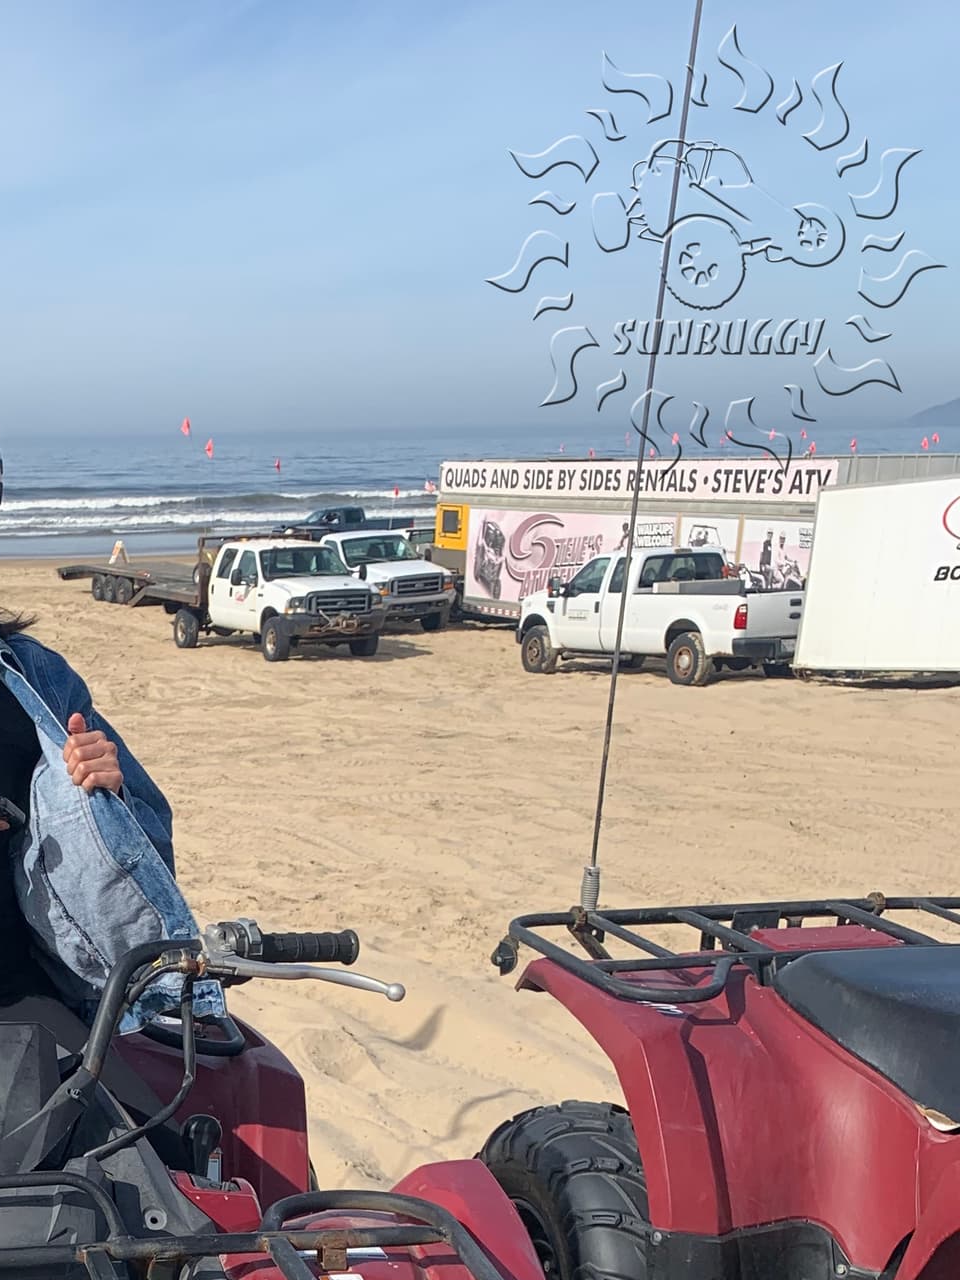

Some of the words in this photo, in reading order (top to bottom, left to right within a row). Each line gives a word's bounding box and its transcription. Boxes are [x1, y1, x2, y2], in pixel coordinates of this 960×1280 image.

[444, 468, 487, 489] QUADS
[490, 468, 520, 490] AND
[523, 468, 554, 490] SIDE
[557, 469, 576, 490] BY
[579, 468, 622, 491] SIDES
[626, 468, 698, 493] RENTALS
[711, 468, 785, 494] STEVE'S
[789, 468, 832, 495] ATV
